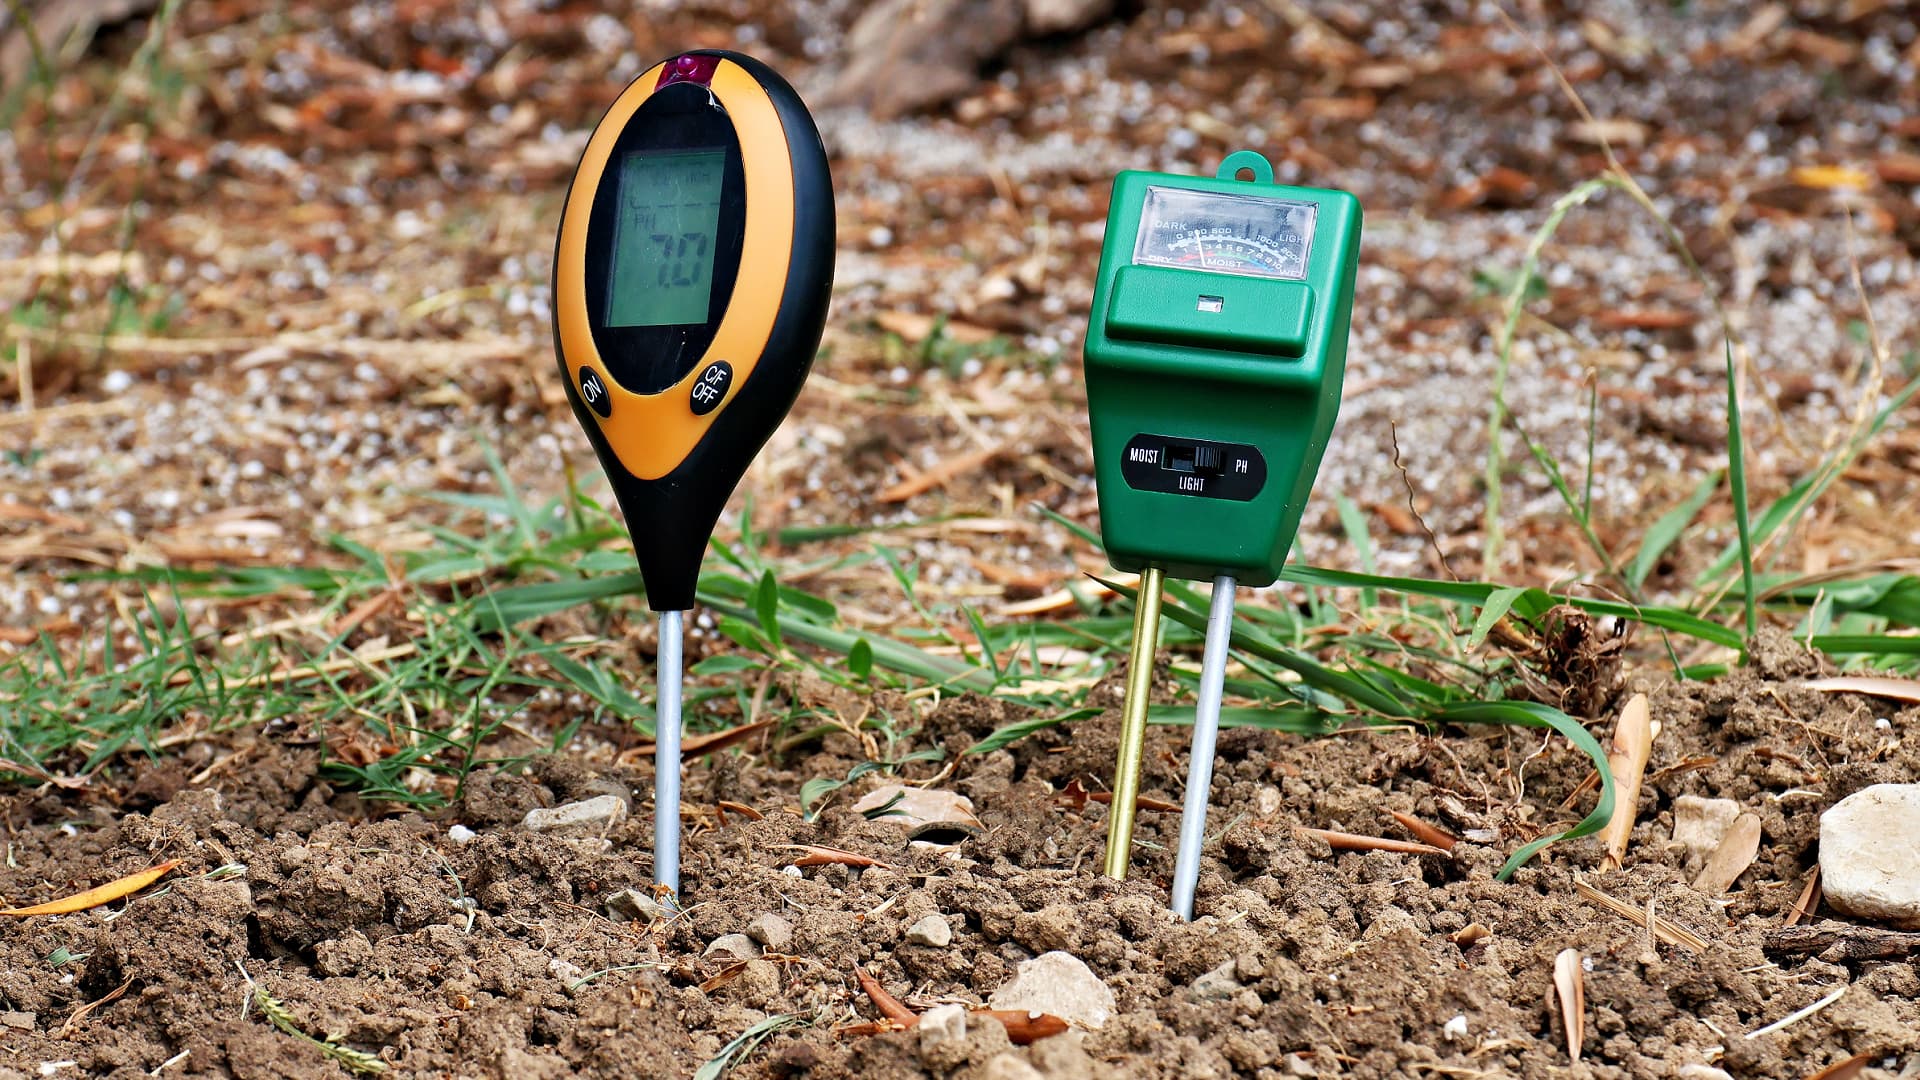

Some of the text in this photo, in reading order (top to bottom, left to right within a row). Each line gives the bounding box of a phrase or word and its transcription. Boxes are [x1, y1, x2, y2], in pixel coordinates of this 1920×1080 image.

[1155, 220, 1187, 231] DARK
[1256, 234, 1279, 248] 1000
[1148, 255, 1173, 264] DRY
[1206, 257, 1243, 268] MOIST
[582, 375, 602, 403] ON
[692, 382, 719, 404] OFF
[1129, 447, 1159, 464] MOIST
[1235, 459, 1248, 474] PH
[1179, 476, 1205, 492] LIGHT
